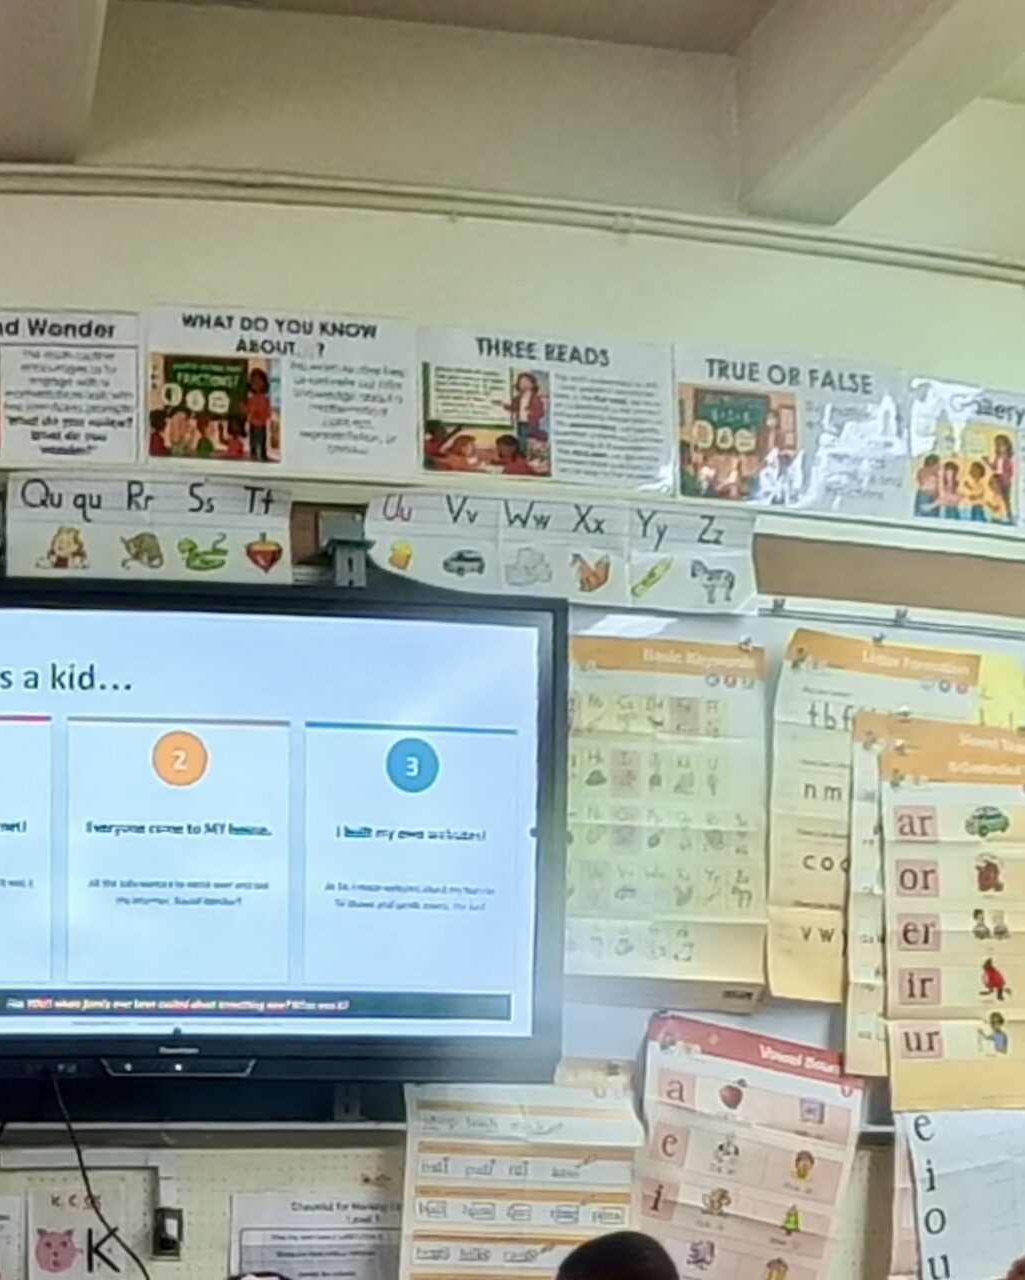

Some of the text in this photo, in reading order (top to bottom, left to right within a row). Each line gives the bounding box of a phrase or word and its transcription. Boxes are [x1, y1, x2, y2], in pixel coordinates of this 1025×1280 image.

[27, 317, 116, 339] Wonder
[182, 313, 378, 340] WHAT DO YOU KNOW
[475, 336, 611, 367] THREE READS
[705, 358, 874, 395] TRUE OR FALSE
[21, 478, 276, 523] Qu qu Rr Ss Tt
[382, 493, 726, 551] Uu Vv Ww Xx Yy Zz
[23, 668, 40, 690] a
[50, 662, 133, 691] kid...
[824, 702, 837, 730] b
[172, 750, 188, 771] 2
[405, 756, 419, 777] 3
[803, 783, 842, 801] n m
[187, 823, 201, 835] to
[897, 812, 934, 837] ar
[802, 855, 835, 871] c o
[899, 866, 937, 891] or
[800, 926, 836, 943] v w
[901, 921, 937, 945] er
[907, 972, 934, 999] ir
[903, 1030, 940, 1052] ur
[665, 1079, 686, 1103] a
[912, 1114, 936, 1142] e
[661, 1133, 678, 1157] e
[925, 1159, 937, 1193] i
[650, 1183, 664, 1212] i
[924, 1207, 947, 1236] o
[87, 1227, 121, 1273] K
